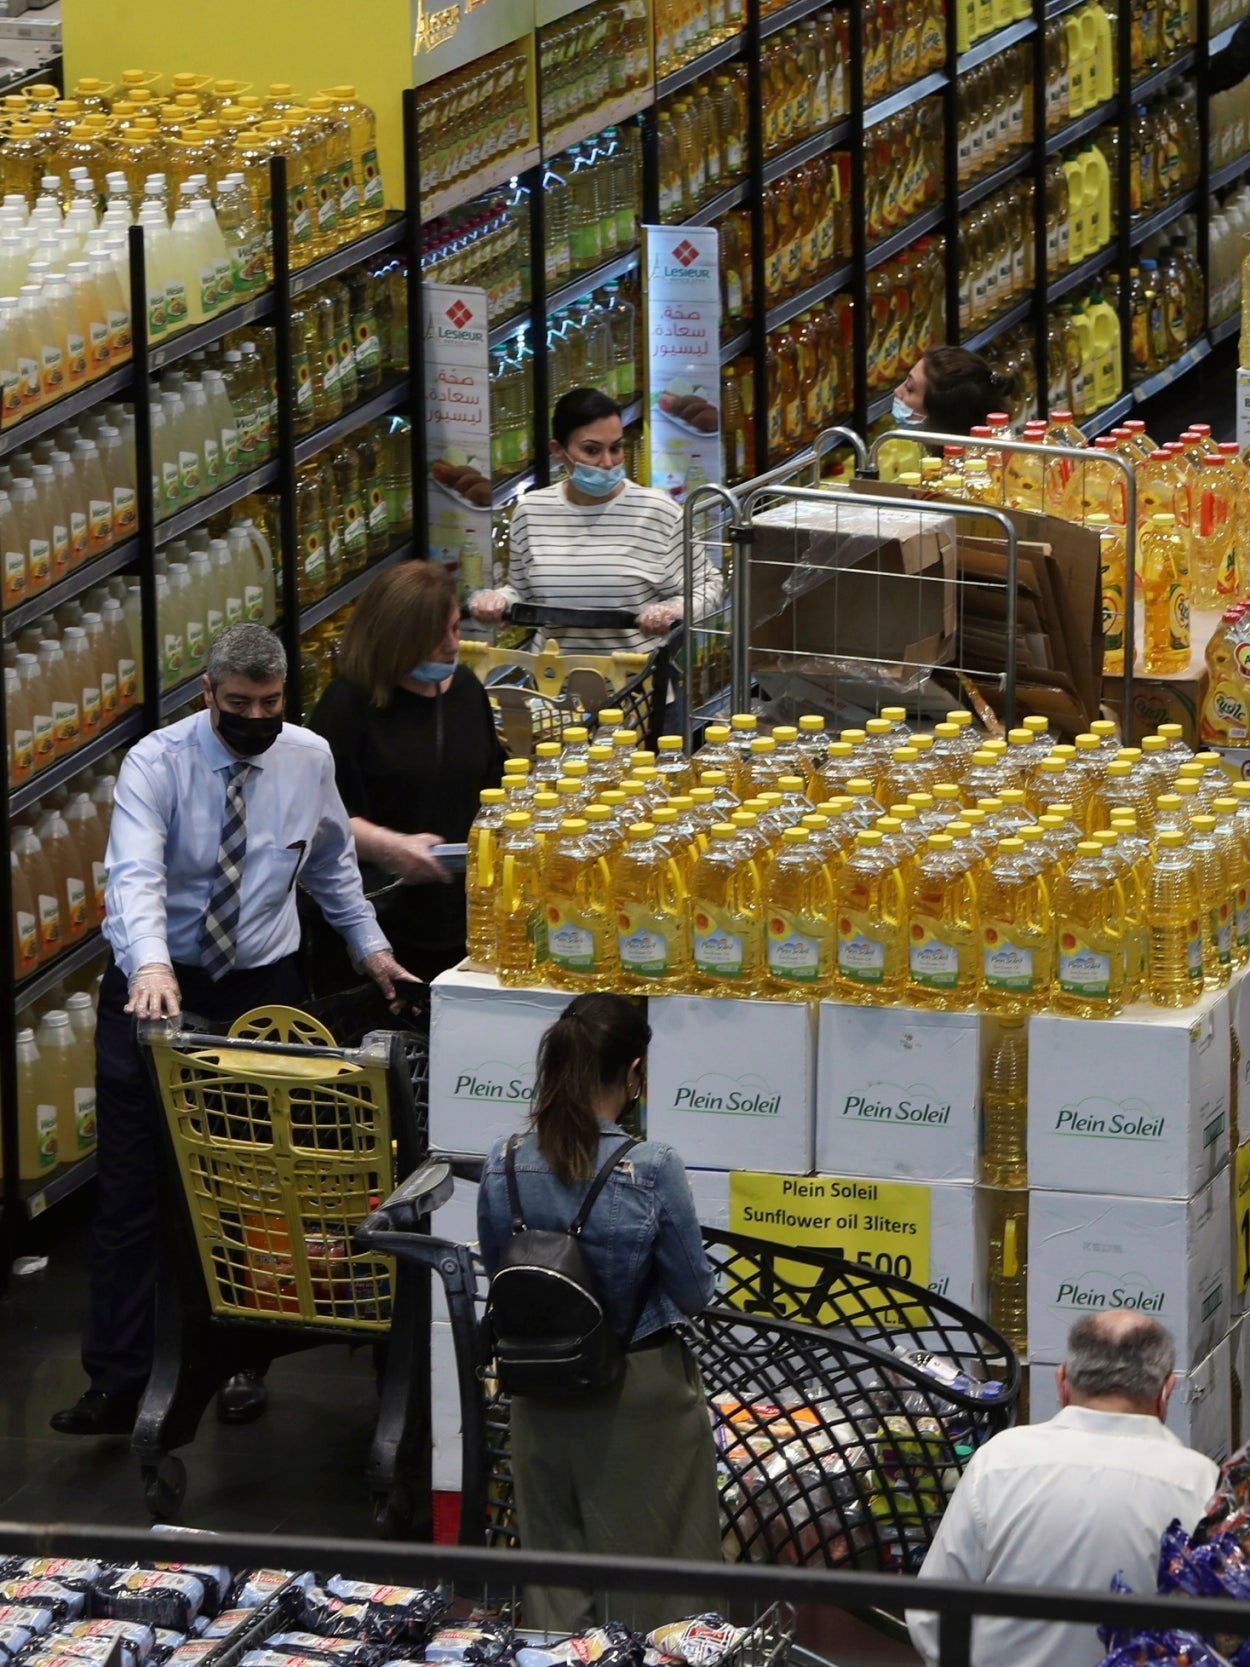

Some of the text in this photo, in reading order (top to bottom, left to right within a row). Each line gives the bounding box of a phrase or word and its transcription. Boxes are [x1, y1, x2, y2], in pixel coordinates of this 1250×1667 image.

[652, 341, 709, 358] ليسيور
[426, 408, 483, 426] ليسيور
[454, 1075, 503, 1098] Plein
[674, 1087, 782, 1115] Plein Soleil
[843, 1095, 951, 1125] Plein Soleil
[1056, 1110, 1165, 1137] Plein Soleil
[783, 1180, 878, 1201] Plein Soleil
[744, 1206, 917, 1235] Sunflower oil 3liters
[1056, 1284, 1165, 1312] Plein Soleil
